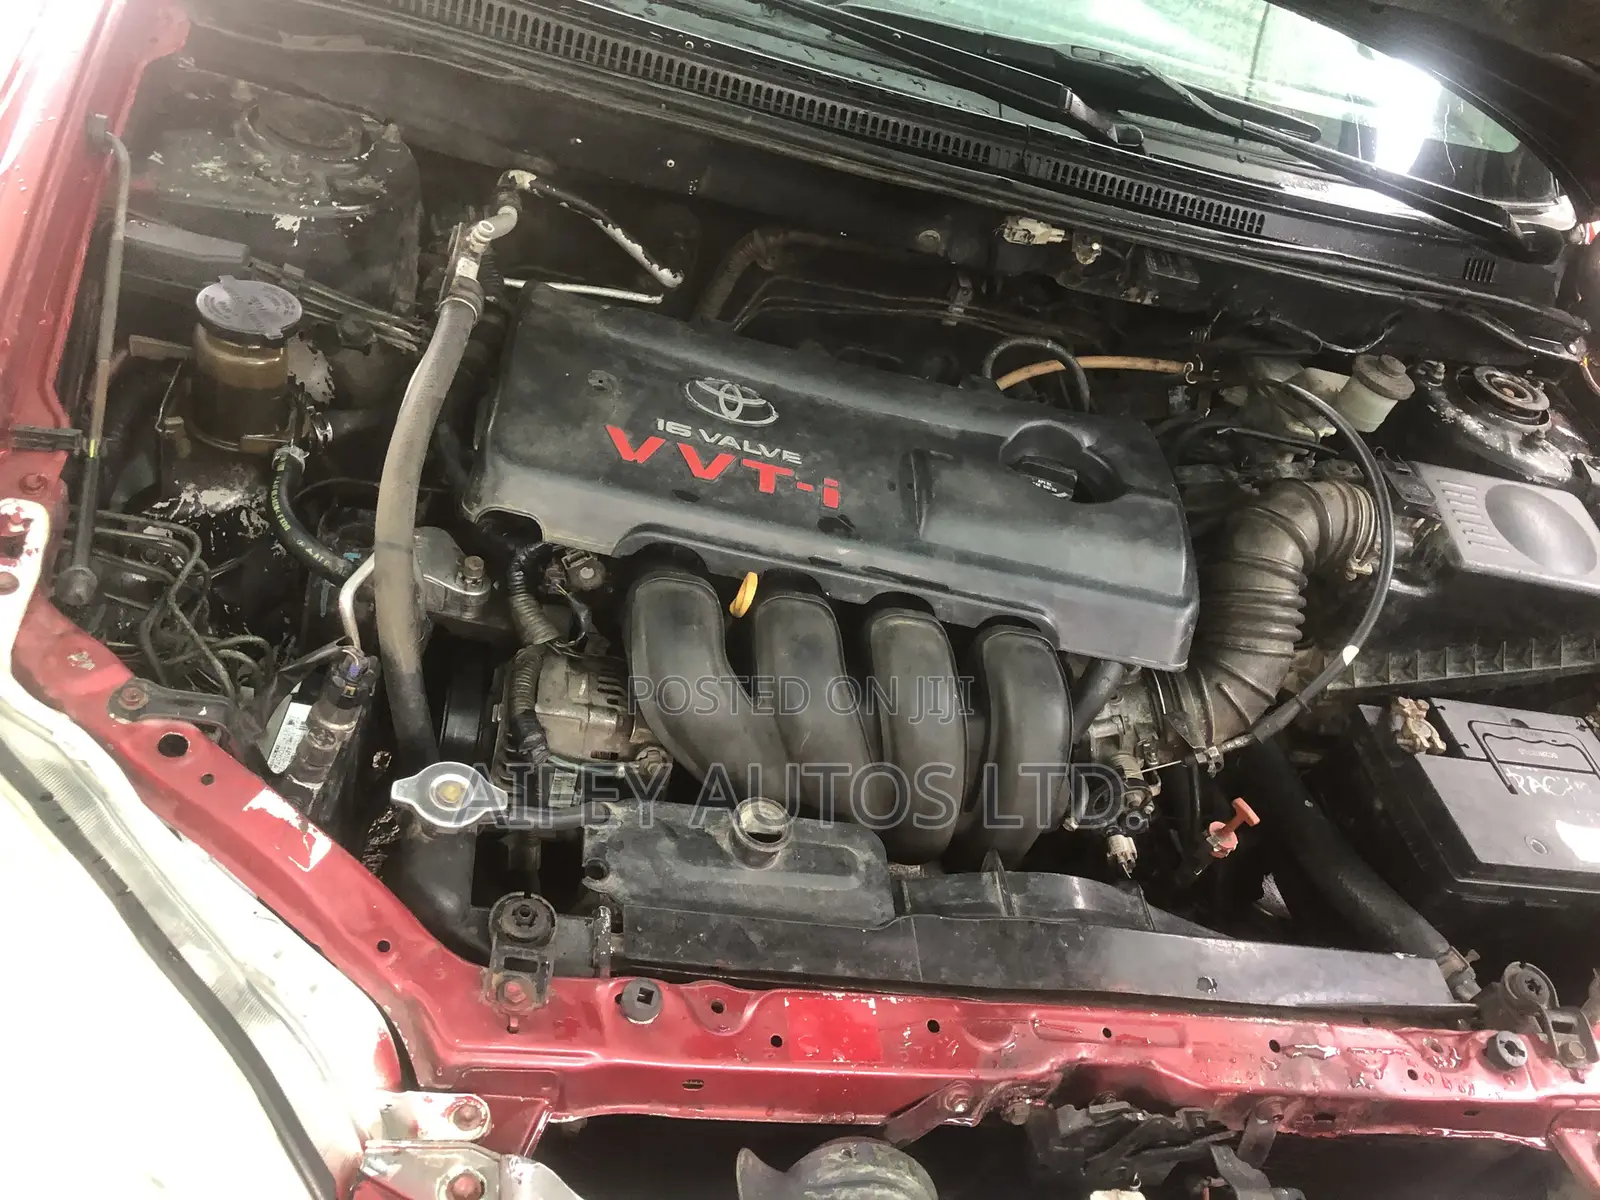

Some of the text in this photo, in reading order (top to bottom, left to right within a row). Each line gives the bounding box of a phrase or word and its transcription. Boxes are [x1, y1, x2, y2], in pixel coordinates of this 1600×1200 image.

[605, 424, 839, 509] VVT-i
[657, 418, 803, 465] 16 VALVE
